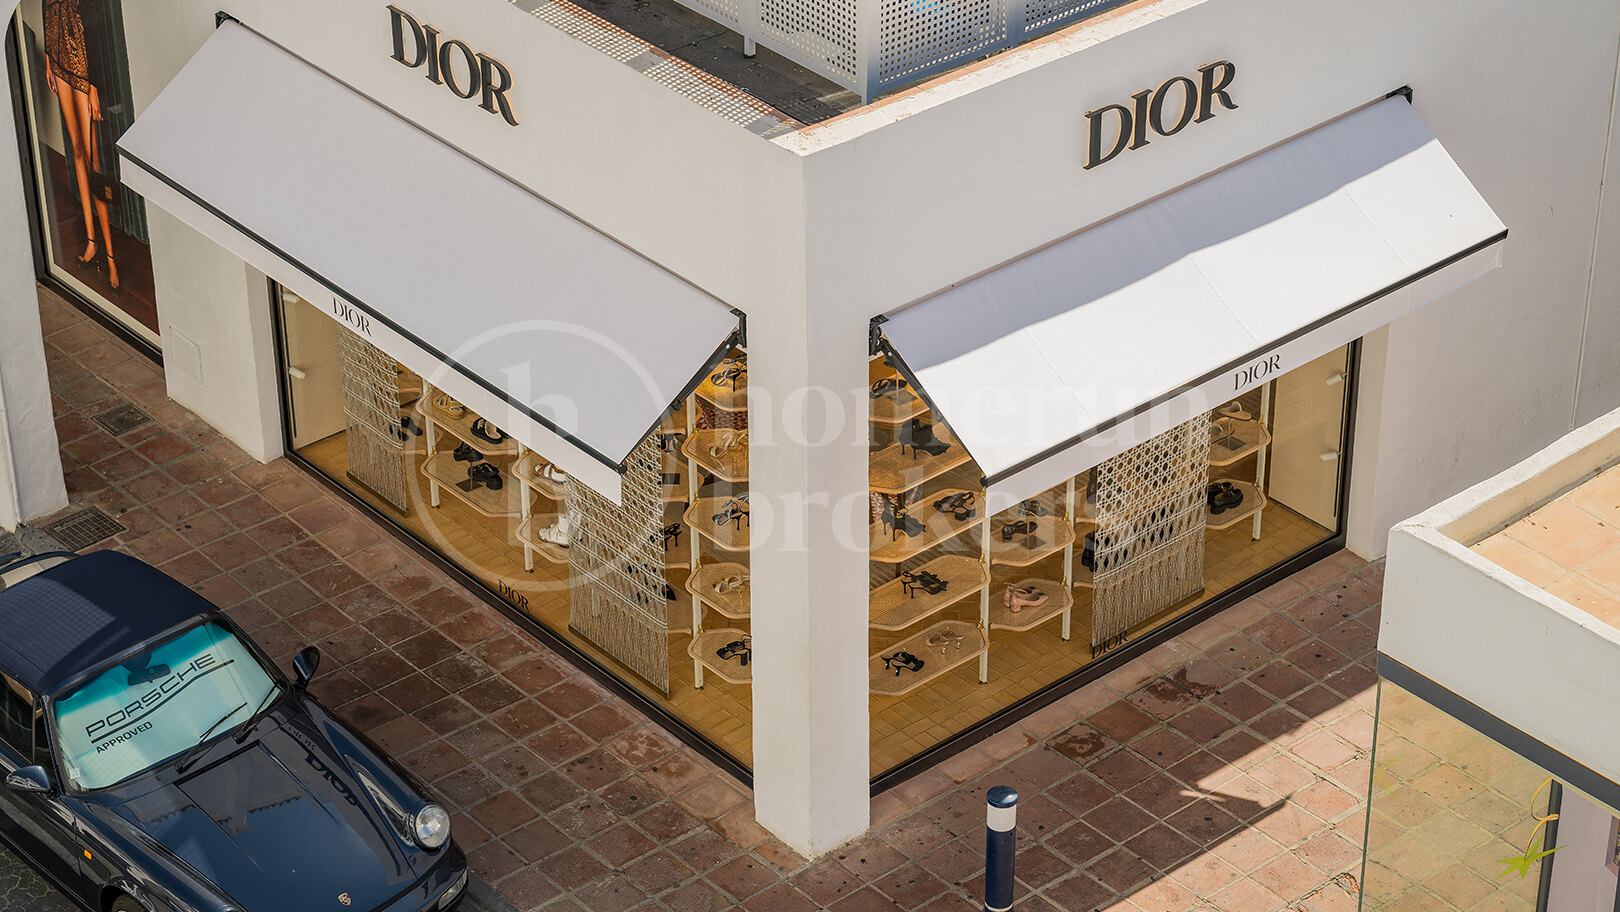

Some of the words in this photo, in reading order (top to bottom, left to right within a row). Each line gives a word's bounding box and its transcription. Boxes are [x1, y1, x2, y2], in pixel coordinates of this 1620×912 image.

[386, 4, 520, 127] DIOR
[1083, 60, 1239, 170] DIOR
[332, 296, 372, 337] DIOR
[1233, 354, 1281, 391] DIOR
[498, 579, 530, 613] DIOR
[1091, 630, 1128, 660] DIOR
[85, 653, 216, 737] PORSCHE
[96, 721, 153, 753] APPROVED
